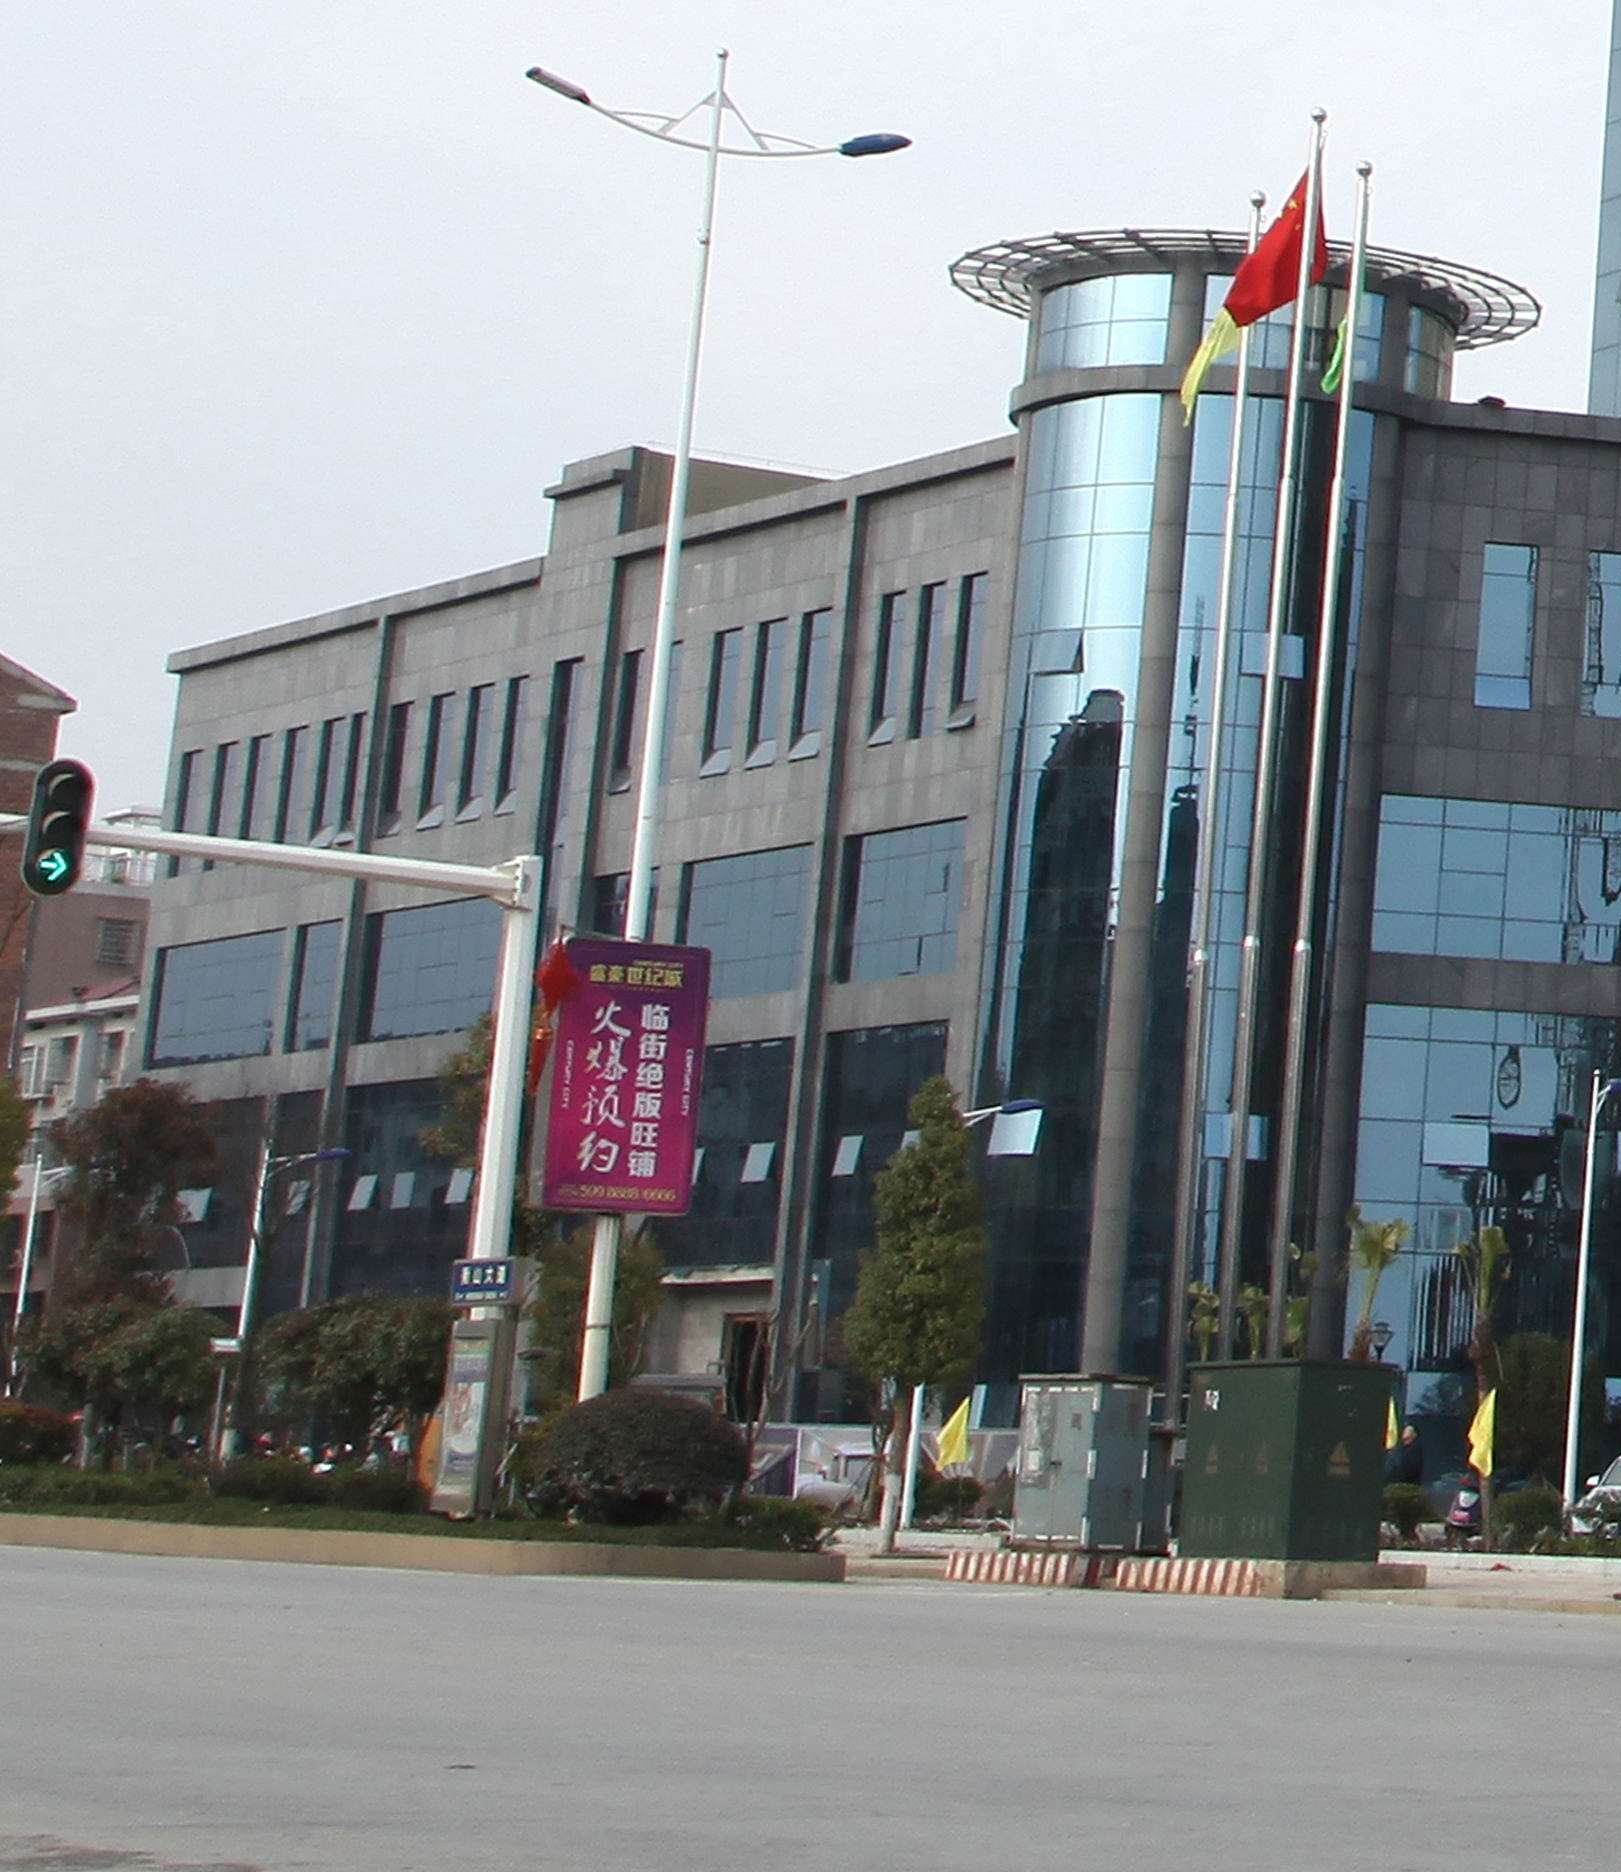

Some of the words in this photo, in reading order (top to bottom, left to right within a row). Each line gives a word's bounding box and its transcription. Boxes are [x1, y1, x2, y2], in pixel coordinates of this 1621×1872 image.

[576, 1000, 632, 1173] 火爆预约
[626, 1003, 670, 1178] 临街绝版旺铺
